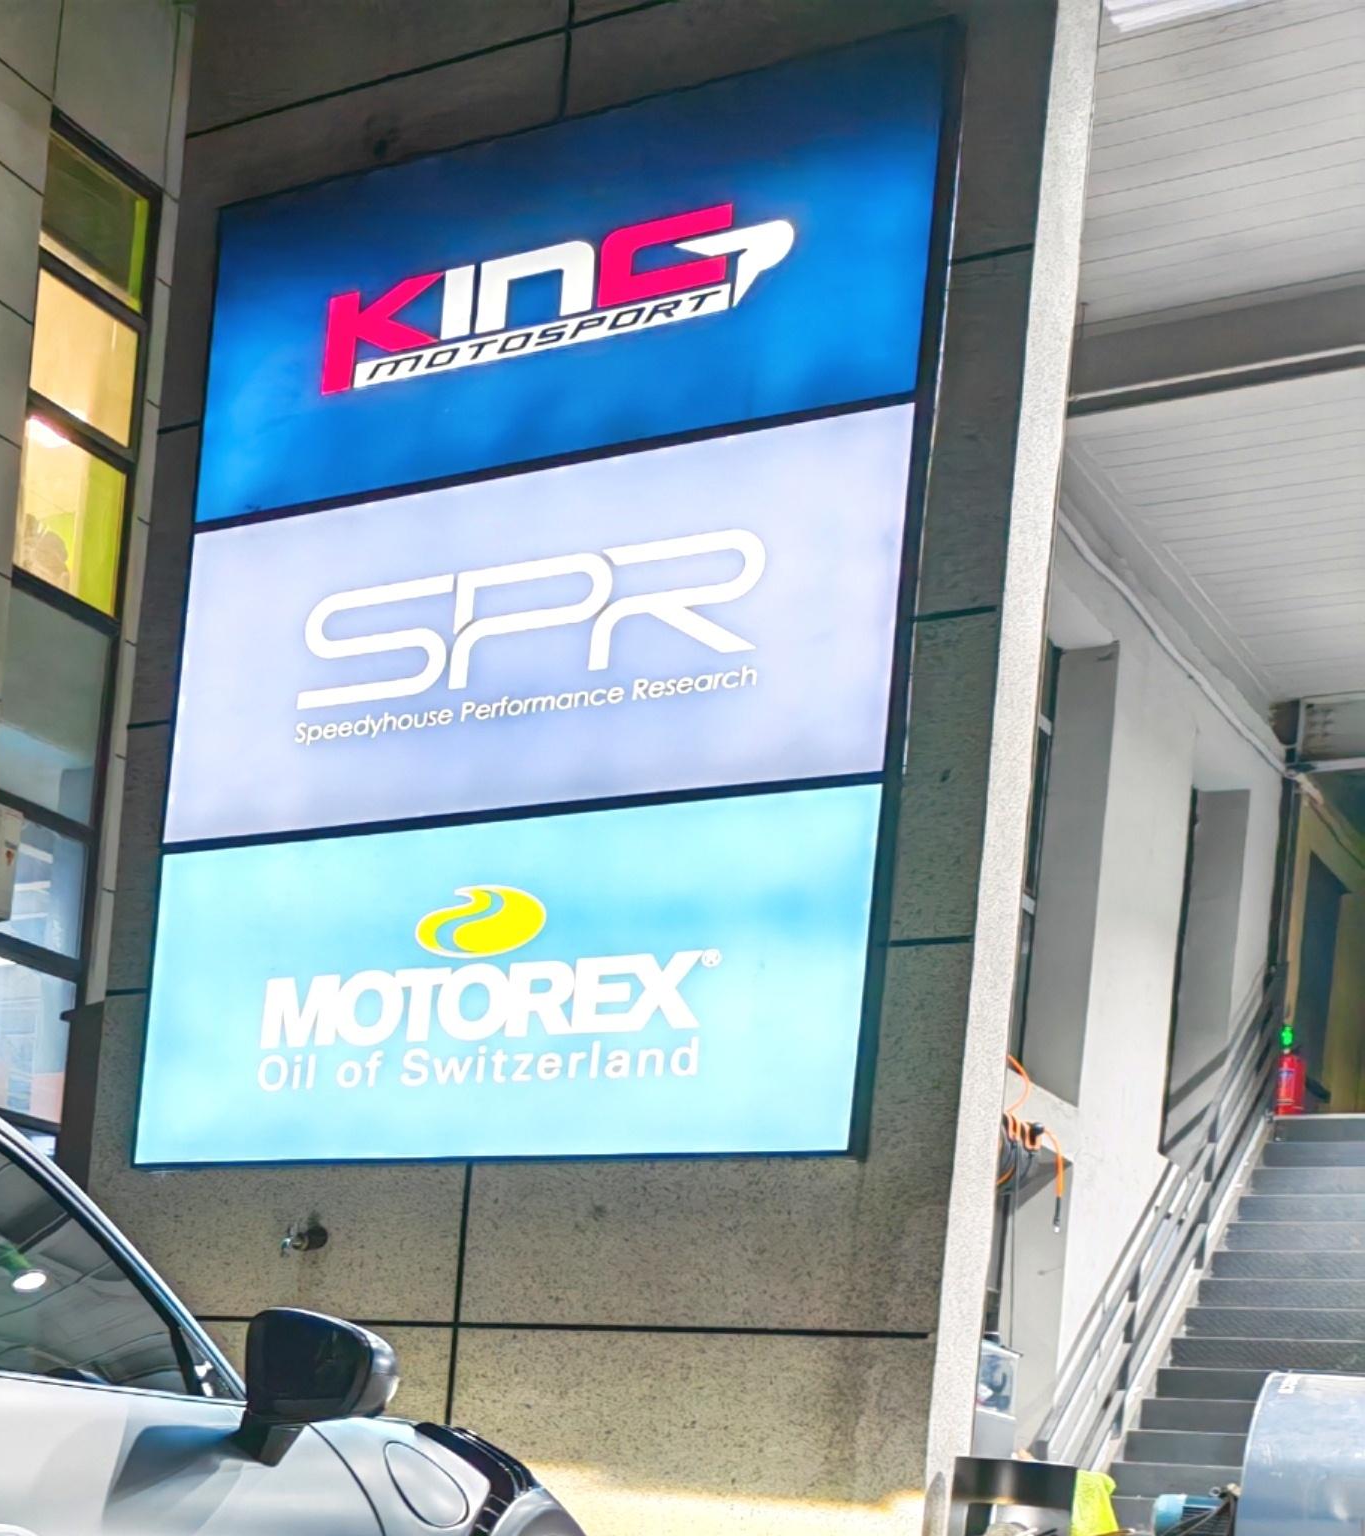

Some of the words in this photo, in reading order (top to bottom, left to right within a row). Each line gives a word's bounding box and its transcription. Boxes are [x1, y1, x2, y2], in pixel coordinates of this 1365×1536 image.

[320, 202, 795, 396] KING
[365, 289, 722, 381] MOTOSPORT
[296, 527, 767, 710] SPR
[293, 705, 454, 746] Speedyhouse
[459, 683, 624, 723] Performance
[631, 664, 758, 702] Research
[259, 949, 705, 1050] MOTOREX
[257, 1053, 316, 1091] Oil
[336, 1050, 384, 1088] of
[400, 1036, 700, 1084] Switzerland
